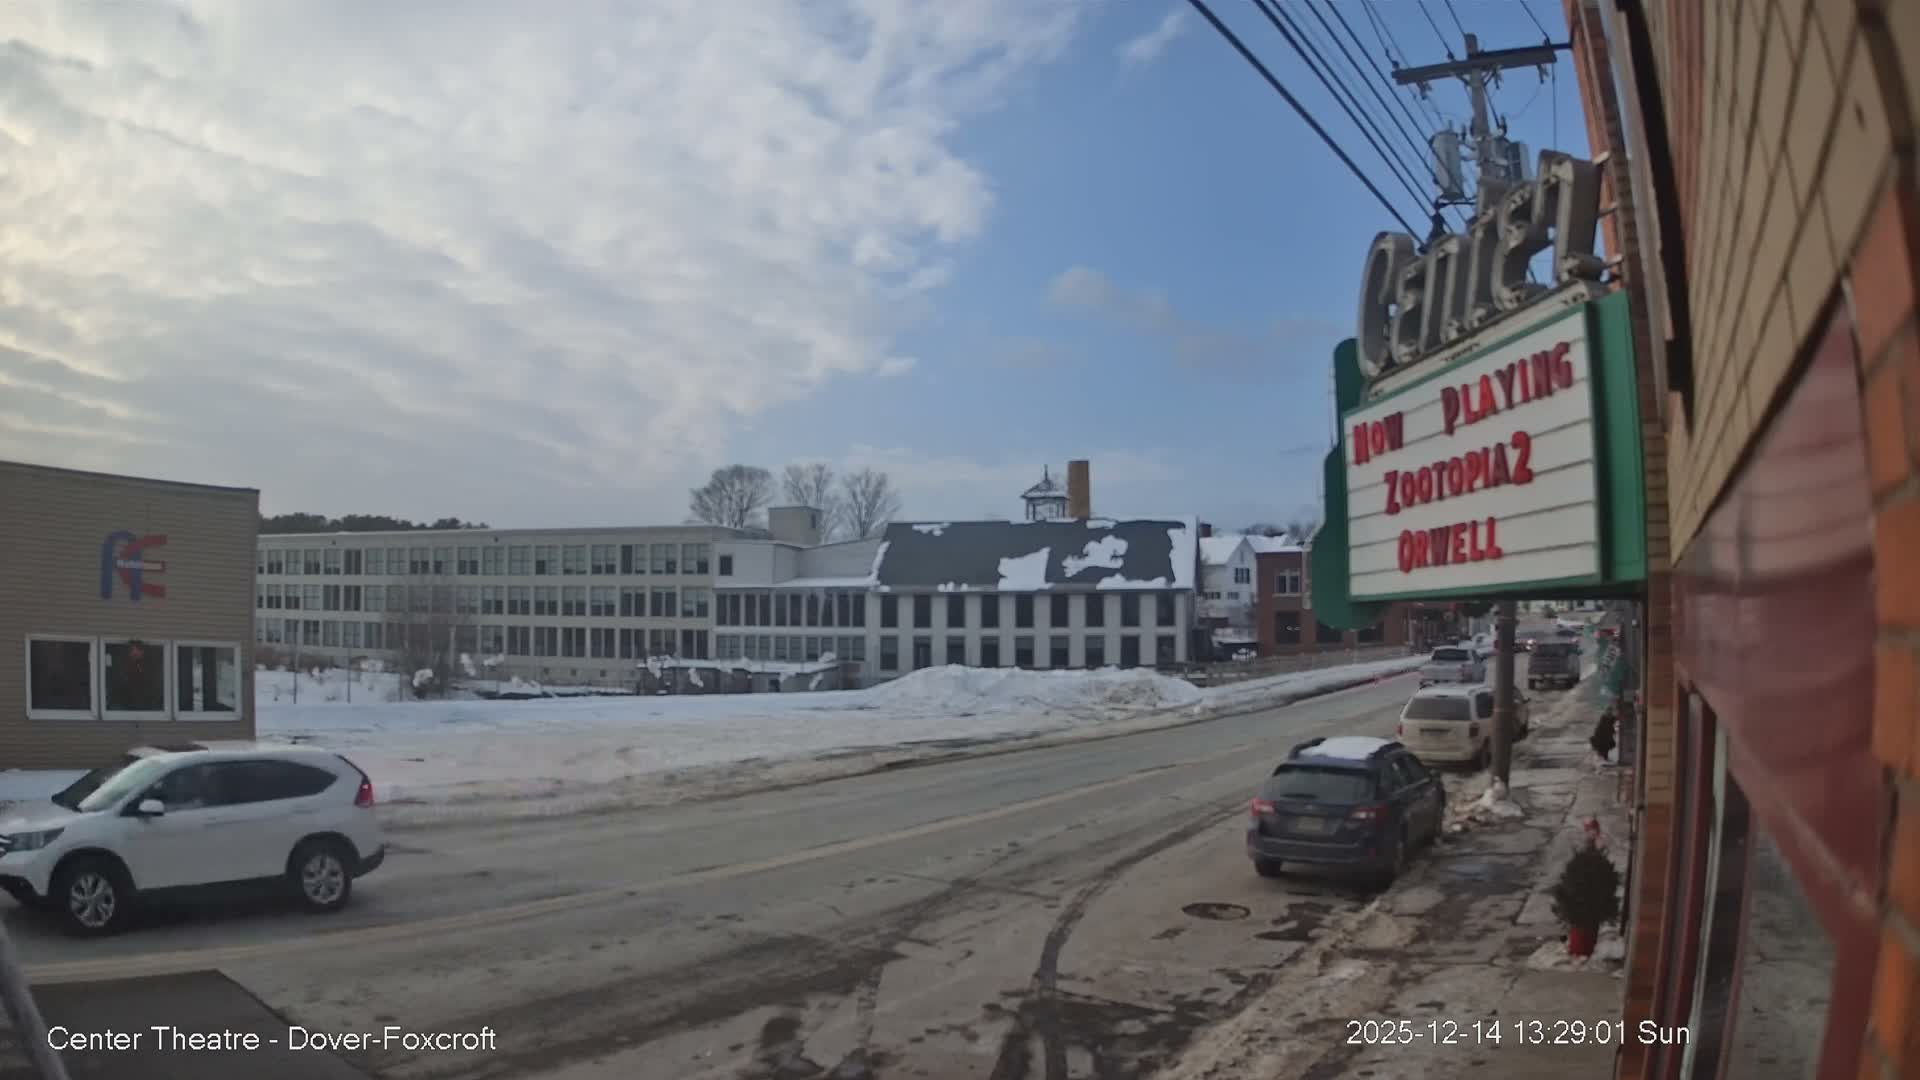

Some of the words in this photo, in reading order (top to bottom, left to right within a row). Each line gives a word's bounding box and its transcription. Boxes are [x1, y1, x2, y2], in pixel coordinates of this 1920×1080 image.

[1352, 412, 1404, 465] NOW
[1441, 341, 1575, 436] PLAYING
[1383, 431, 1535, 515] ZOOTOPIA2
[1397, 517, 1504, 574] ORWELL
